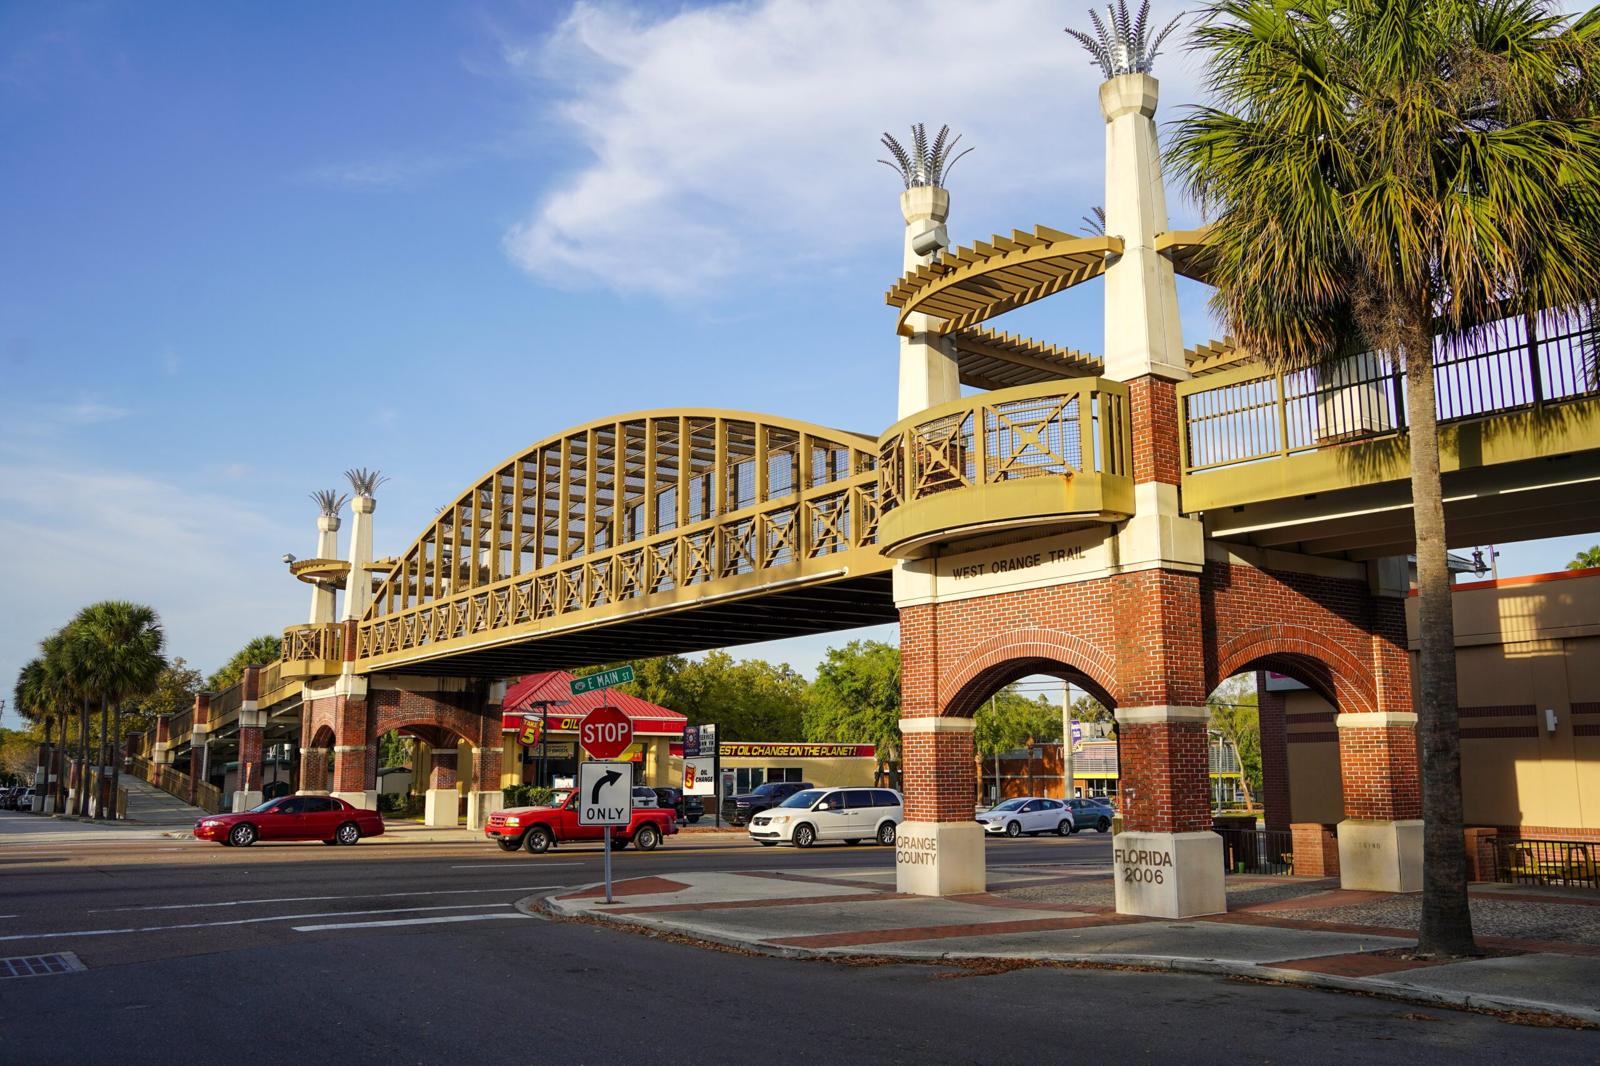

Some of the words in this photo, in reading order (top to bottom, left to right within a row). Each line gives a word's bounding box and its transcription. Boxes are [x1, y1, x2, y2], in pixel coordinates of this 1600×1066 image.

[953, 563, 985, 581] WEST
[991, 553, 1041, 574] ORANGE
[1048, 545, 1086, 564] TRAIL
[587, 677, 595, 690] E
[596, 671, 619, 687] MAIN
[622, 671, 631, 681] ST
[560, 718, 579, 729] OIL
[521, 727, 535, 744] 5
[584, 722, 629, 743] STOP
[737, 745, 751, 756] OIL
[751, 745, 789, 756] CHANGE
[789, 746, 803, 756] ON
[804, 746, 820, 756] THE
[820, 746, 857, 756] PLANET!
[685, 774, 692, 787] 5
[587, 808, 624, 820] ONLY
[896, 835, 937, 851] ORANGE
[896, 850, 937, 866] COUNTY
[1114, 849, 1173, 867] FLORIDA
[1124, 867, 1164, 885] 2006
